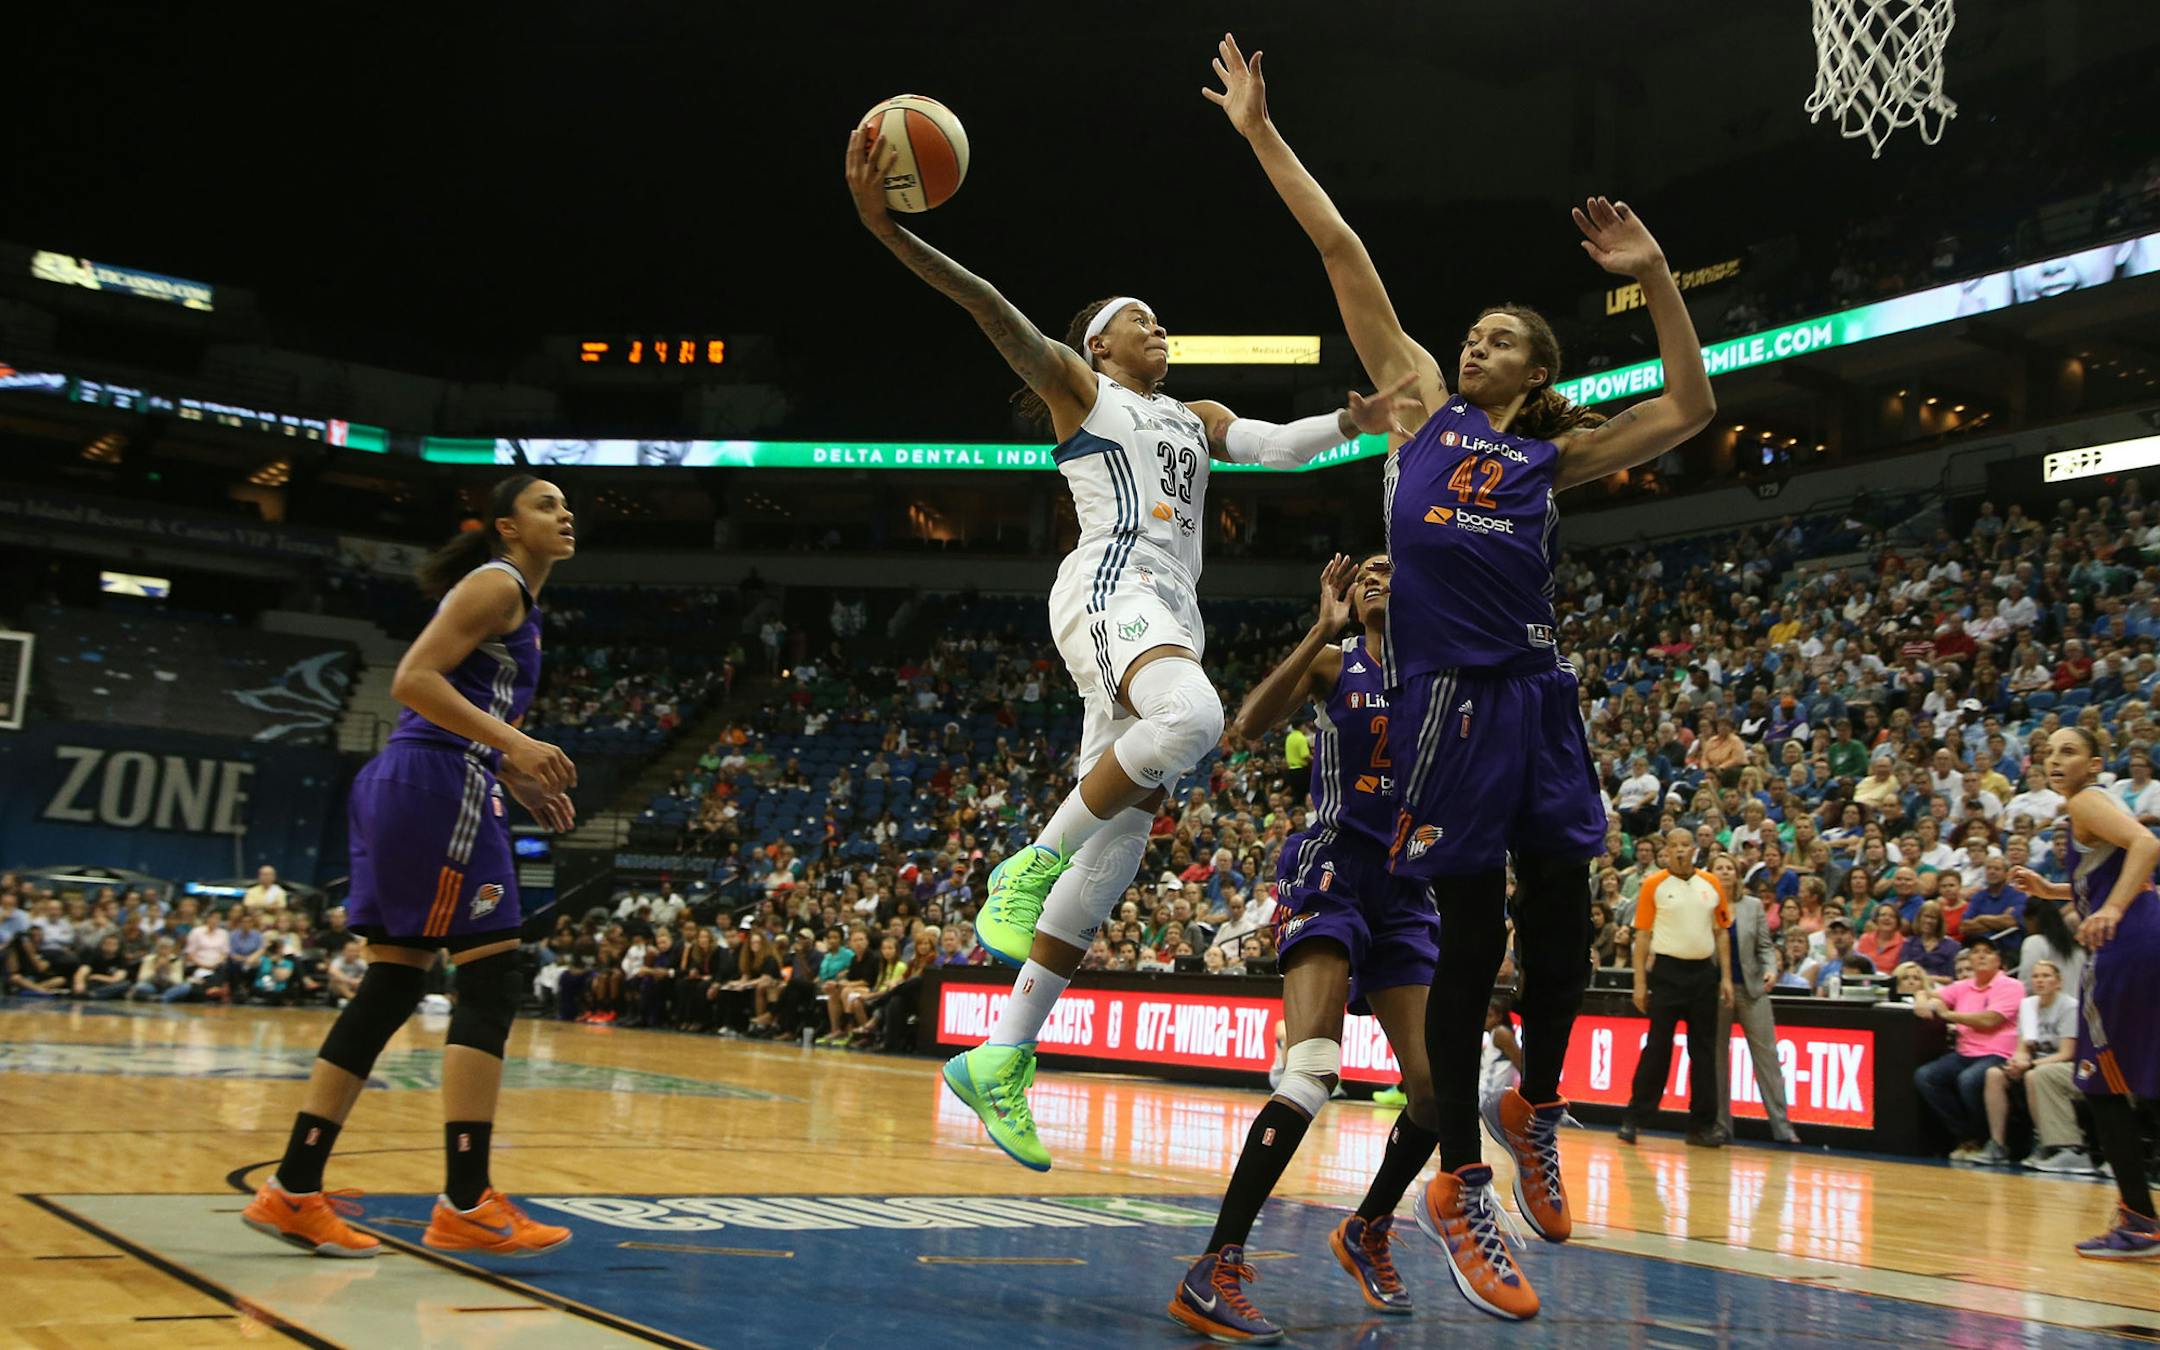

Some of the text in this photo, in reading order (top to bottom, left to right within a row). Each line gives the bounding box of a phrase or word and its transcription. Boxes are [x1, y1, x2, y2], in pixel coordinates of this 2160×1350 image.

[1606, 271, 1681, 316] LIFETE
[1252, 345, 1284, 354] Medical
[814, 449, 883, 464] DELTA
[895, 449, 985, 464] DENTAL
[997, 450, 1057, 465] INDI
[2049, 451, 2102, 478] PPP
[1157, 440, 1197, 505] 33
[1448, 454, 1504, 510] 42
[1456, 508, 1514, 534] boost
[1365, 692, 1390, 708] Lif
[43, 744, 257, 835] ZONE
